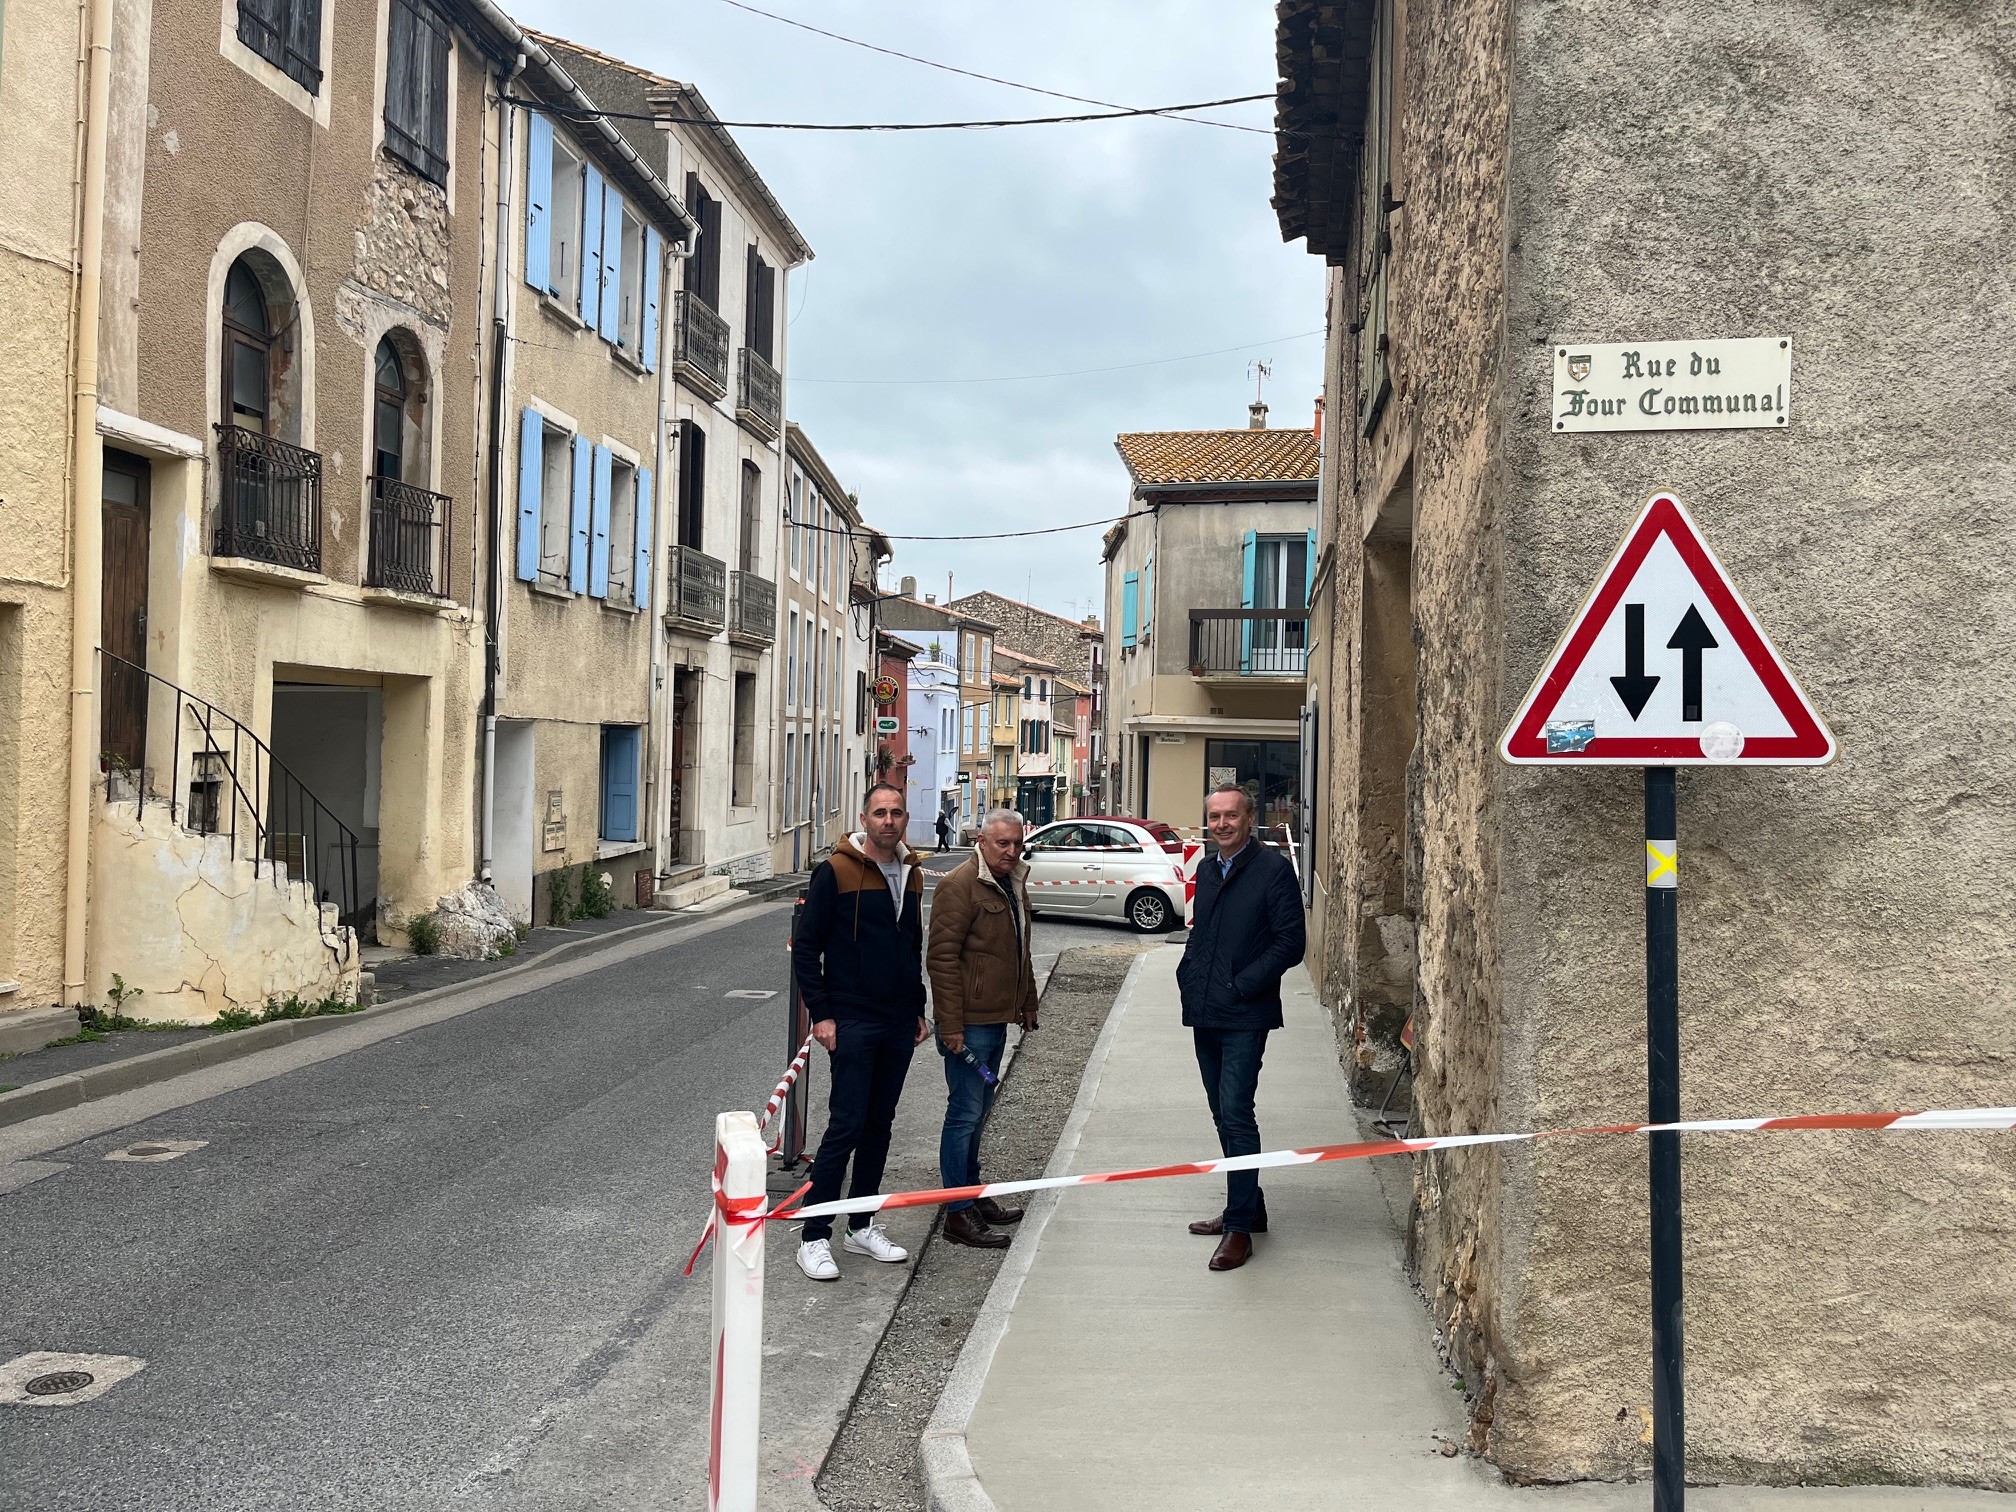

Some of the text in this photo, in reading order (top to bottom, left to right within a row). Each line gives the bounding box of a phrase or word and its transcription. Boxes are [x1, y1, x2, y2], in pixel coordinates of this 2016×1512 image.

[1621, 350, 1722, 379] Rue du
[1559, 384, 1784, 418] Four Communal
